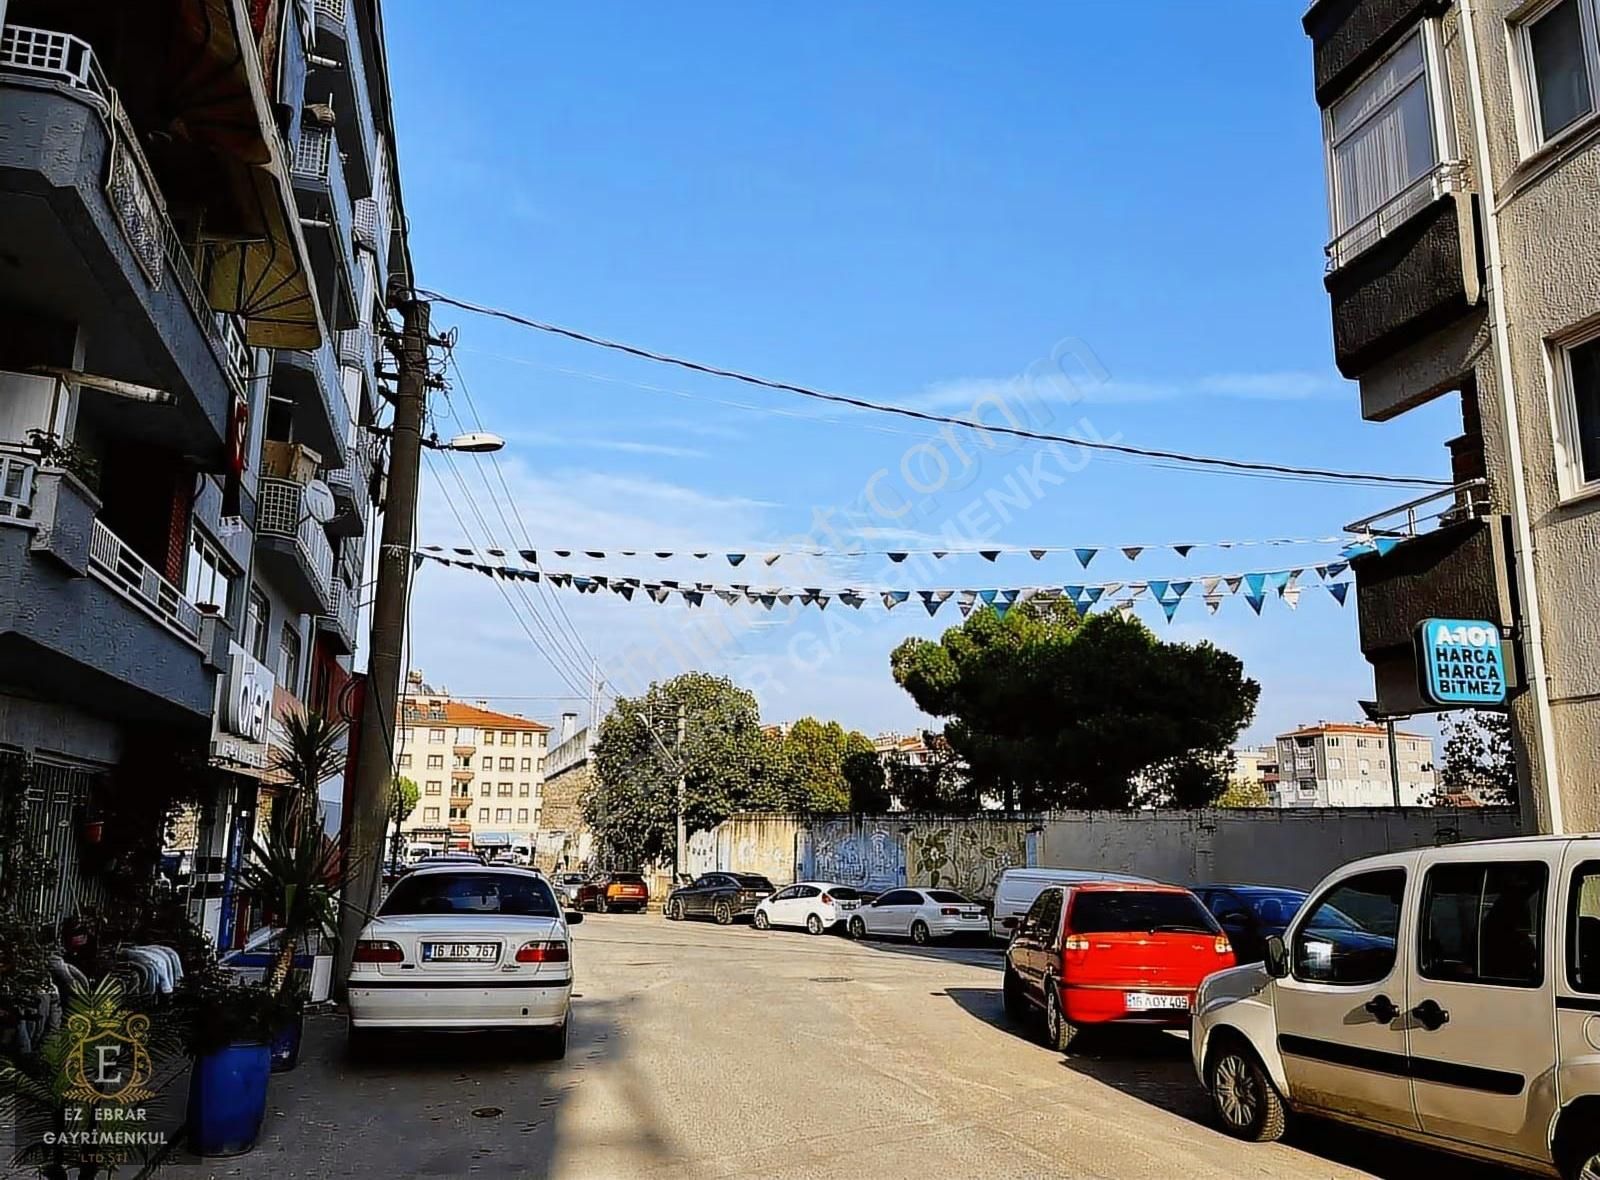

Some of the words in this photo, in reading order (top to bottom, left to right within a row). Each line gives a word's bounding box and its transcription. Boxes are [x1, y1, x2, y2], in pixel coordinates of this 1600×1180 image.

[1436, 648, 1497, 664] HARCA
[1438, 664, 1499, 680] HARCA
[433, 945, 444, 957] 16
[476, 945, 495, 957] 767
